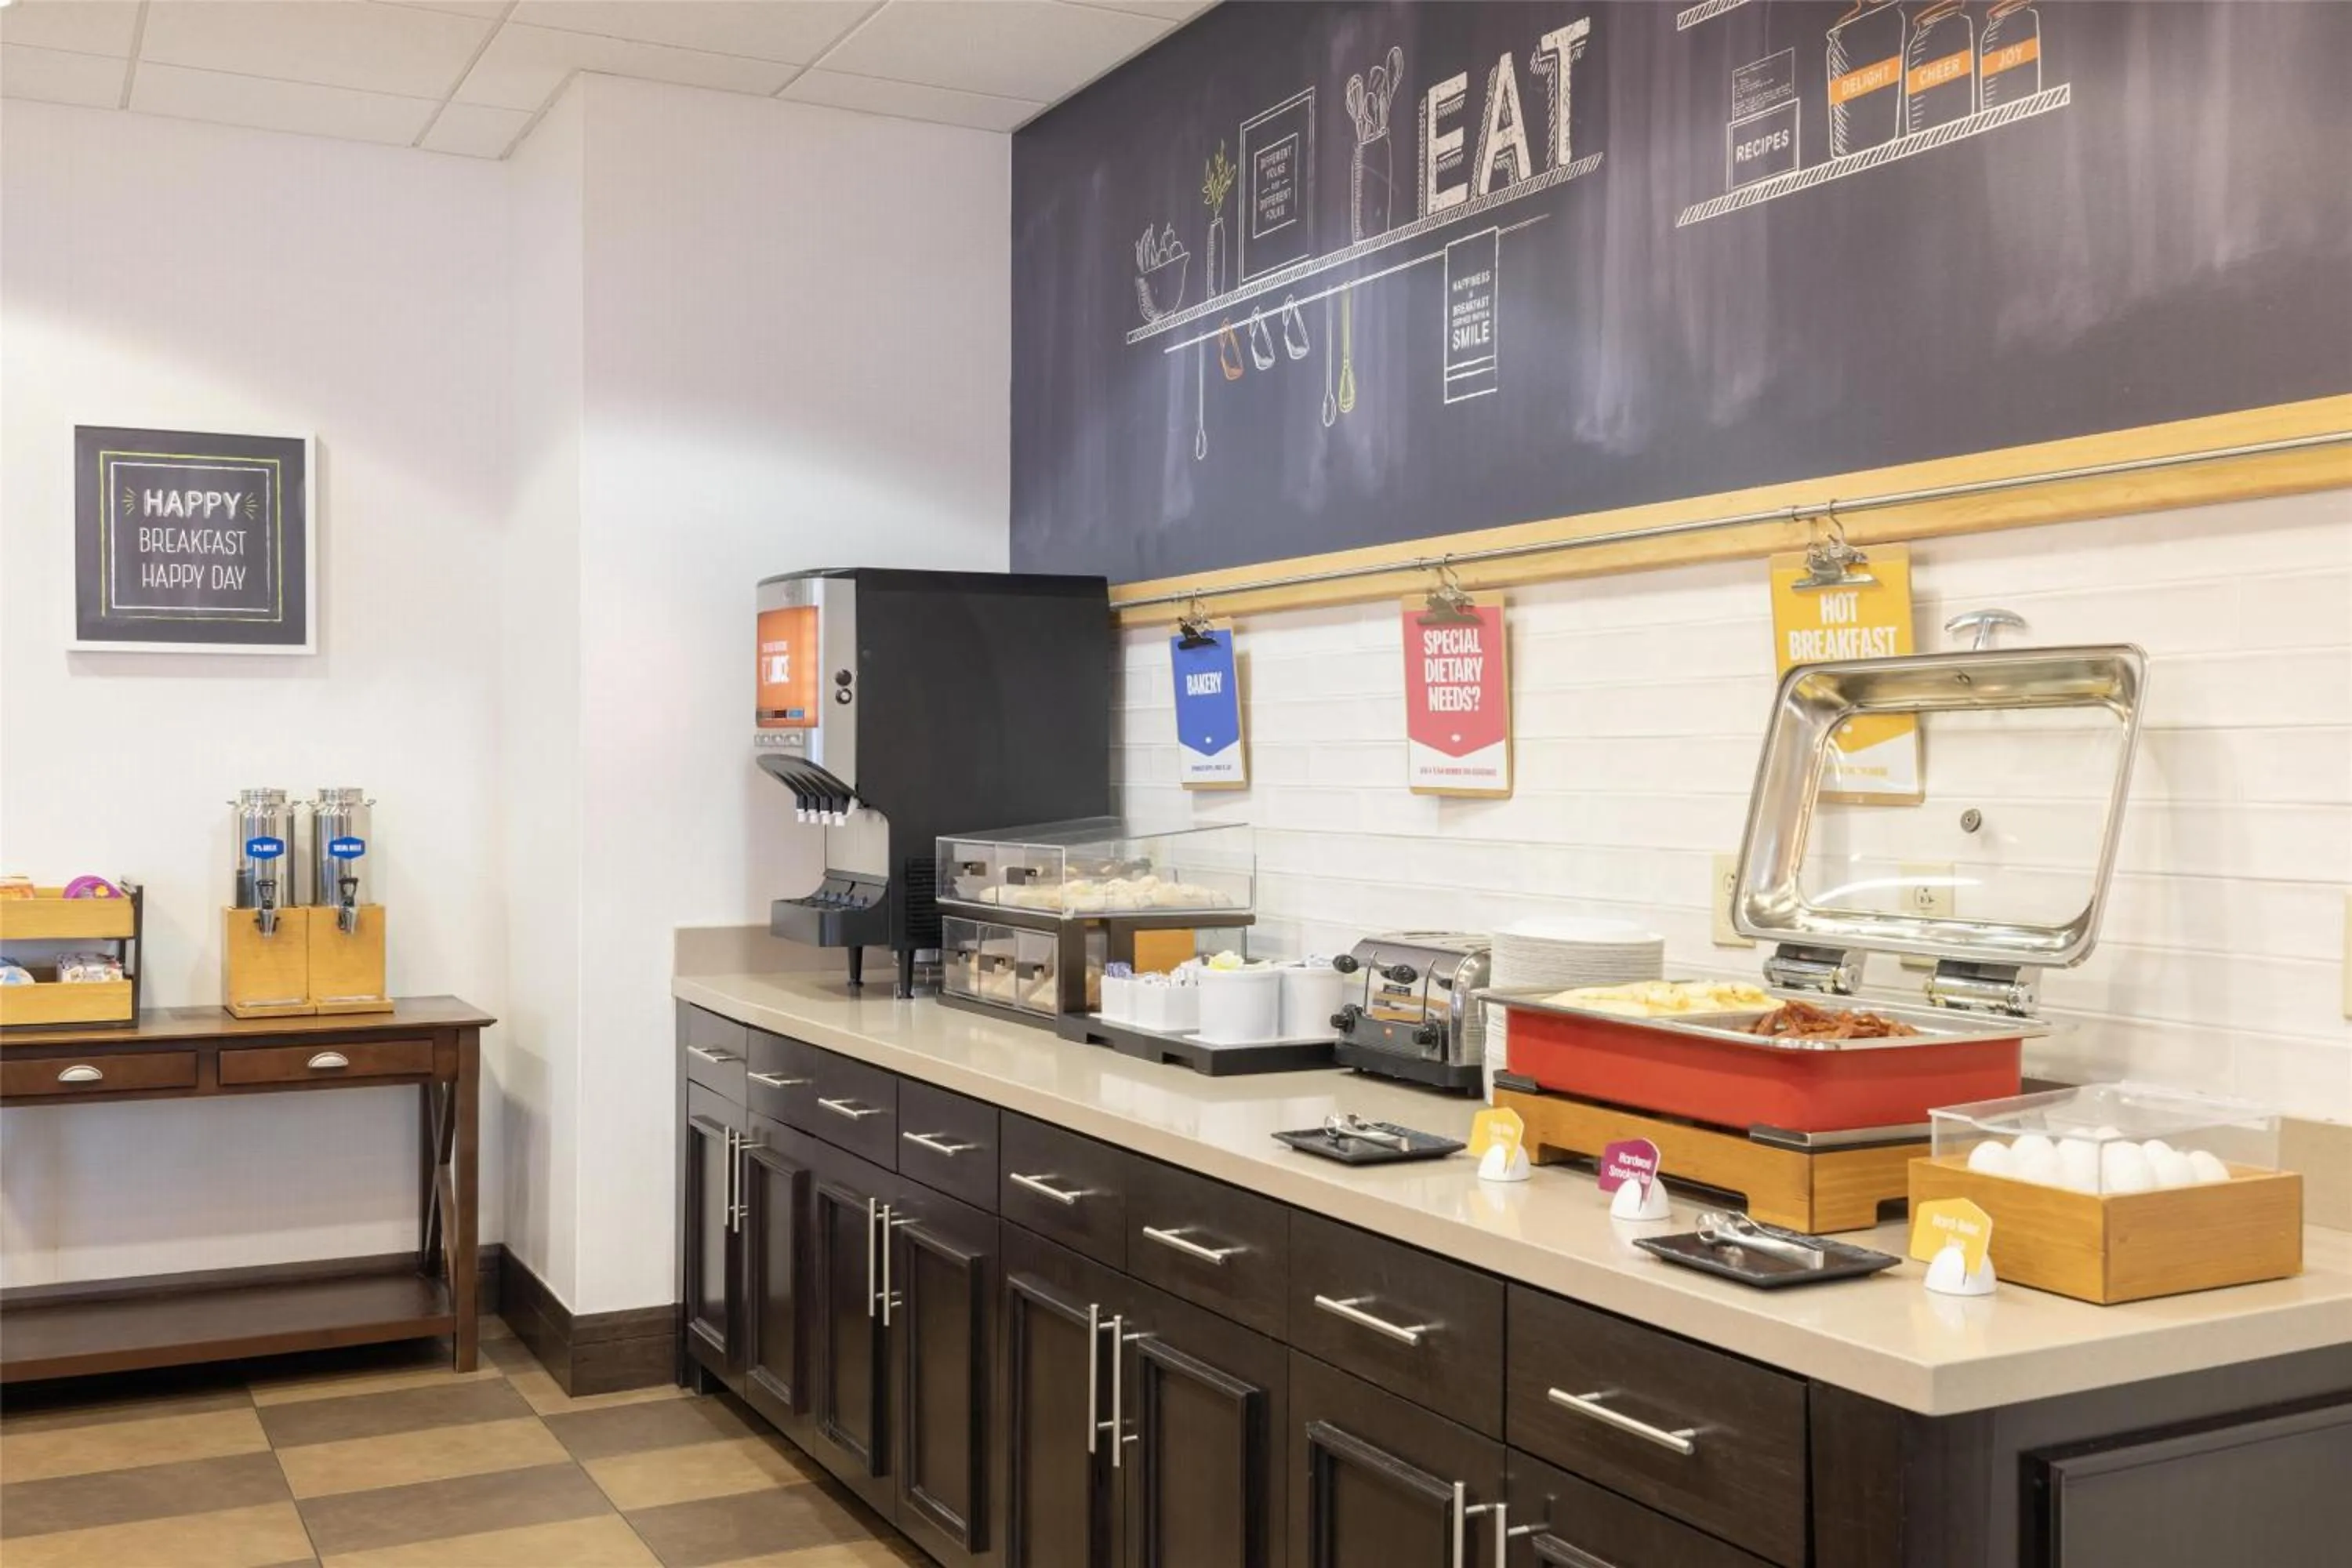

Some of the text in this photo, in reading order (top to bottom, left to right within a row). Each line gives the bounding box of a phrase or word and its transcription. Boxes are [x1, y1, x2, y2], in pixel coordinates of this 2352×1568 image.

[1920, 58, 1960, 83] CHEER
[1998, 44, 2022, 70] JOY
[1842, 65, 1890, 96] DELIGHT
[1421, 16, 1590, 218] EAT
[1737, 128, 1790, 163] RECIPES
[1453, 320, 1490, 351] SMILE
[143, 488, 242, 520] HAPPY
[139, 527, 247, 555] BREAKFAST
[142, 563, 246, 590] HAPPY DAY
[1820, 593, 1859, 625] HOT
[1423, 628, 1483, 655] SPECIAL
[1788, 626, 1897, 661] BREAKFAST
[1185, 671, 1223, 696] BAKERY
[1425, 657, 1483, 684] DIETARY
[1428, 685, 1481, 712] NEEDS?
